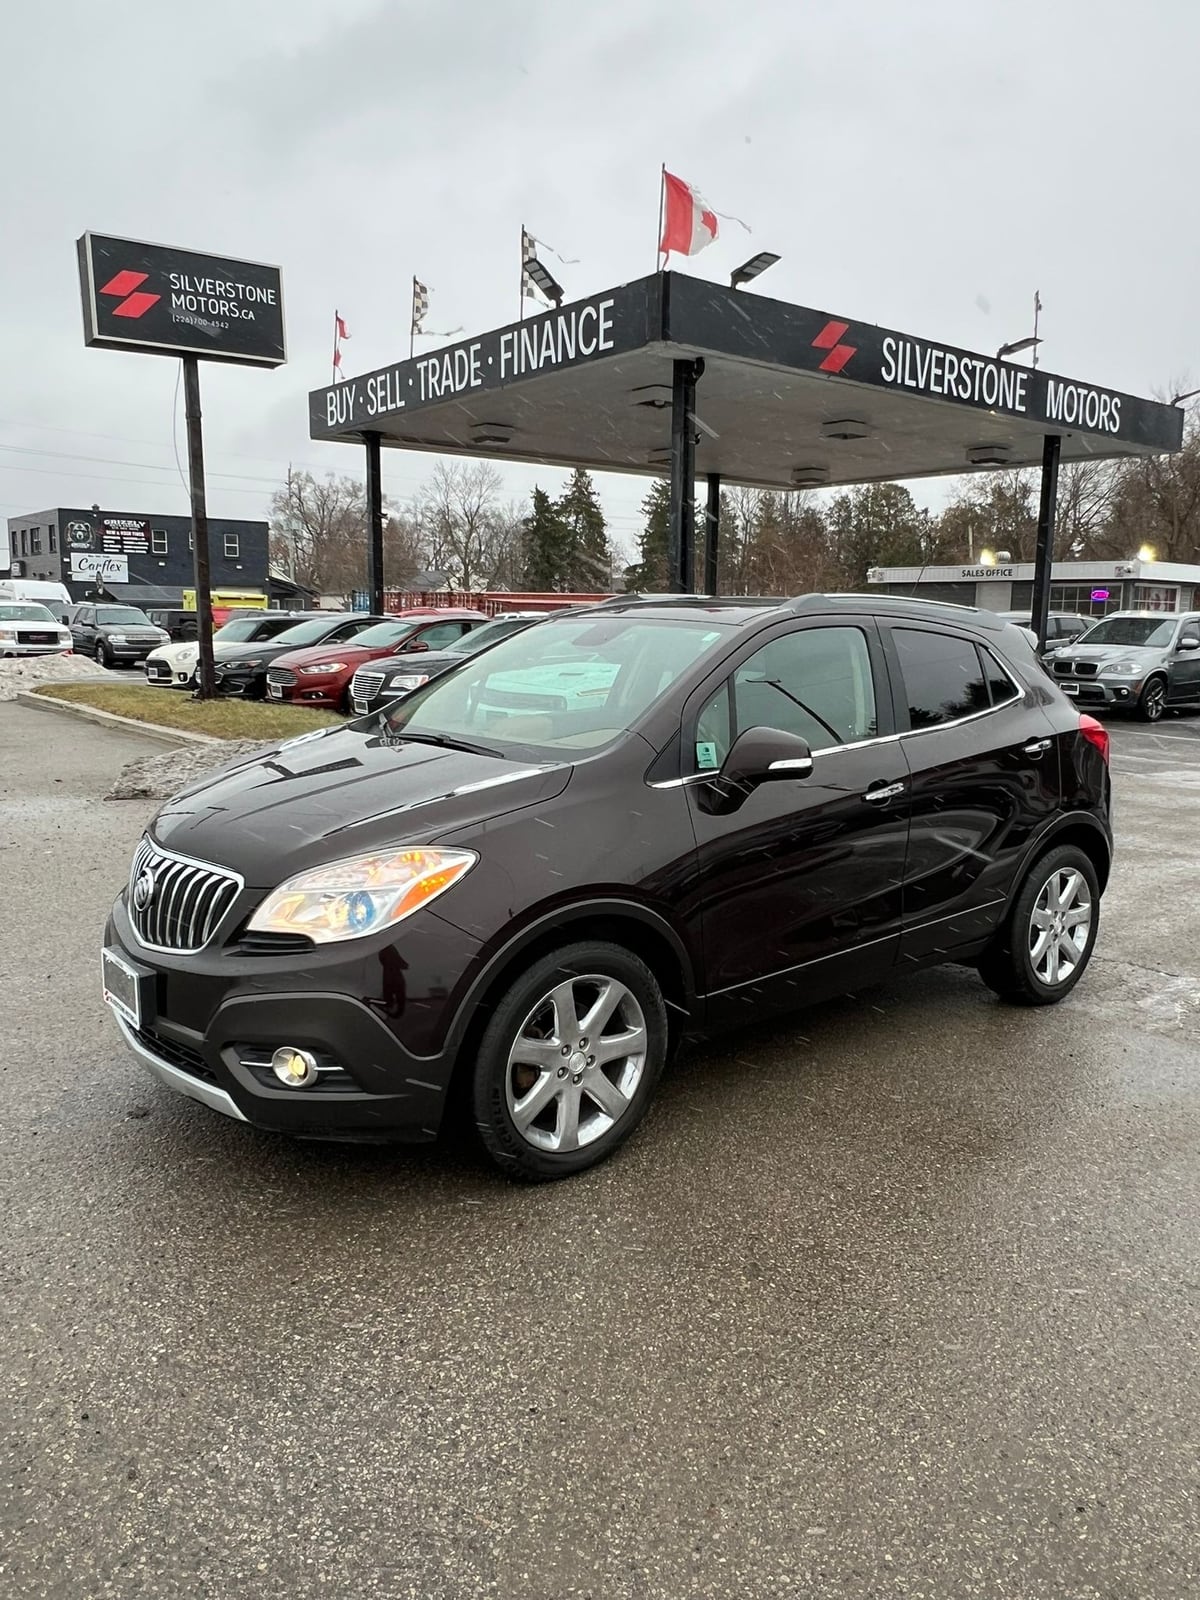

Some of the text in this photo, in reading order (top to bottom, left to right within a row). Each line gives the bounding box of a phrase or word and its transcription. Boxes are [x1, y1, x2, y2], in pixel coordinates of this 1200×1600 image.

[169, 272, 277, 306] SILVERSTONE
[326, 299, 615, 427] BUY SELL TRADE FINANCE
[881, 337, 1122, 433] SILVERSTONE MOTORS
[78, 557, 122, 574] Carflex
[961, 568, 1013, 578] SALES OFFICE
